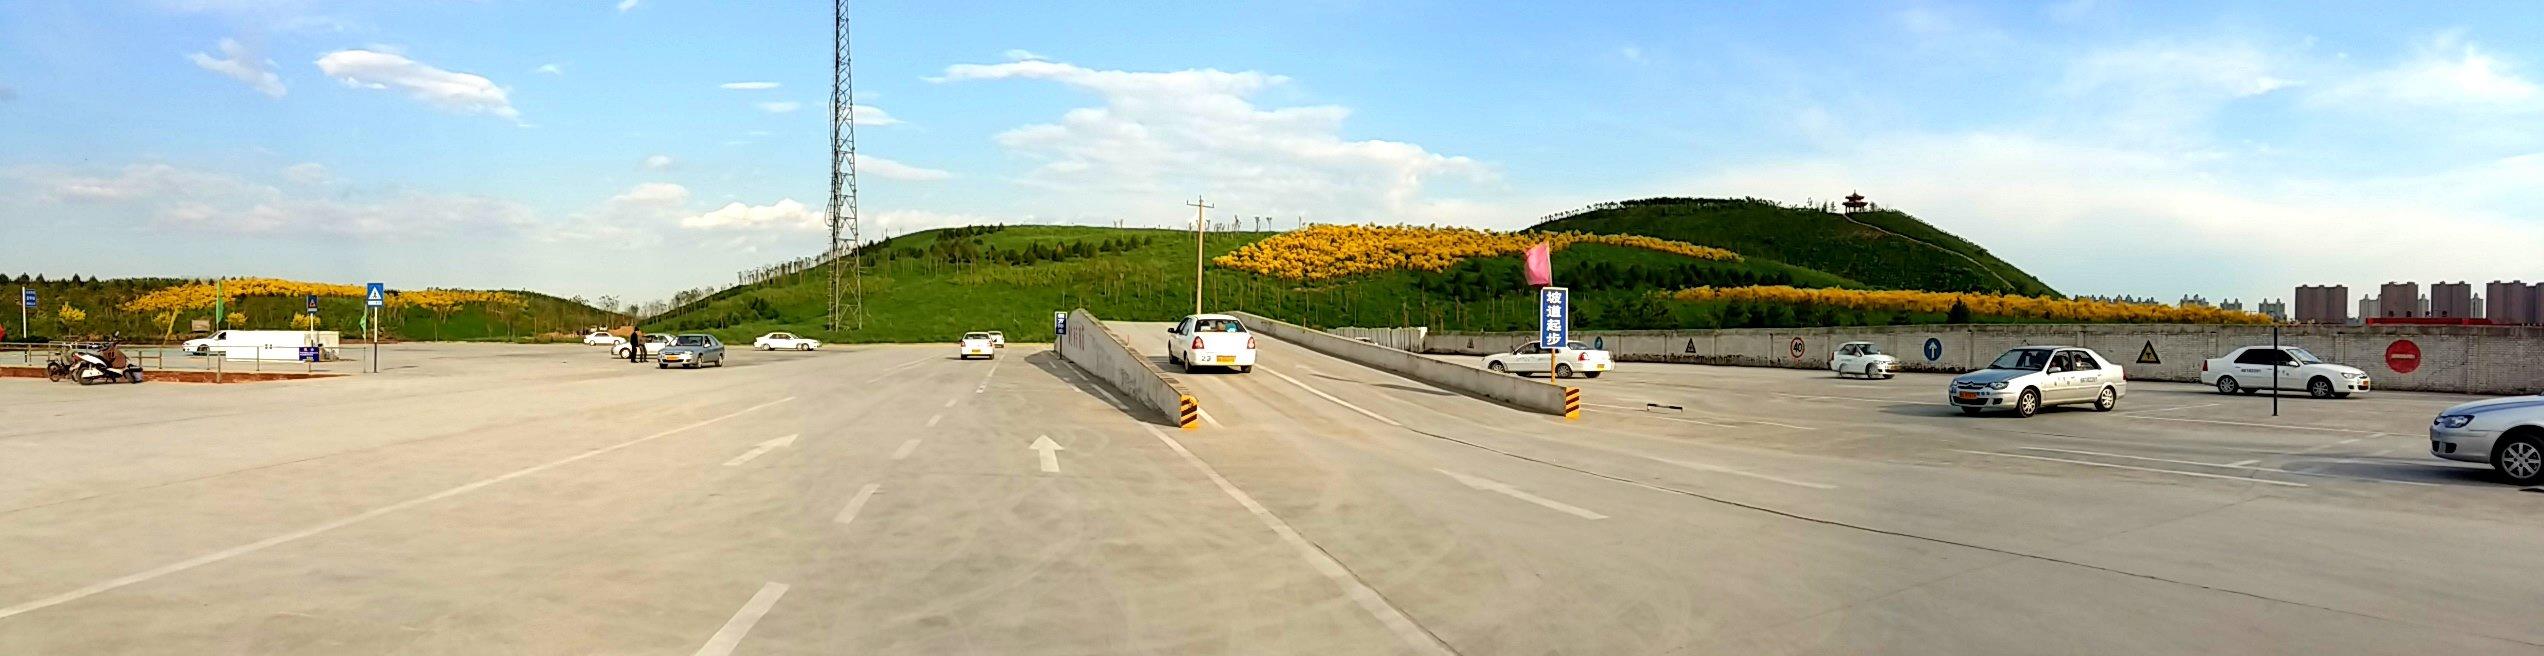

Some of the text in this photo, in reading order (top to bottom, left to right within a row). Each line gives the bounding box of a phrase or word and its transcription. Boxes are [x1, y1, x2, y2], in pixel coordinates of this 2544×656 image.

[1546, 291, 1562, 346] 坡道起步
[1793, 341, 1803, 352] 40
